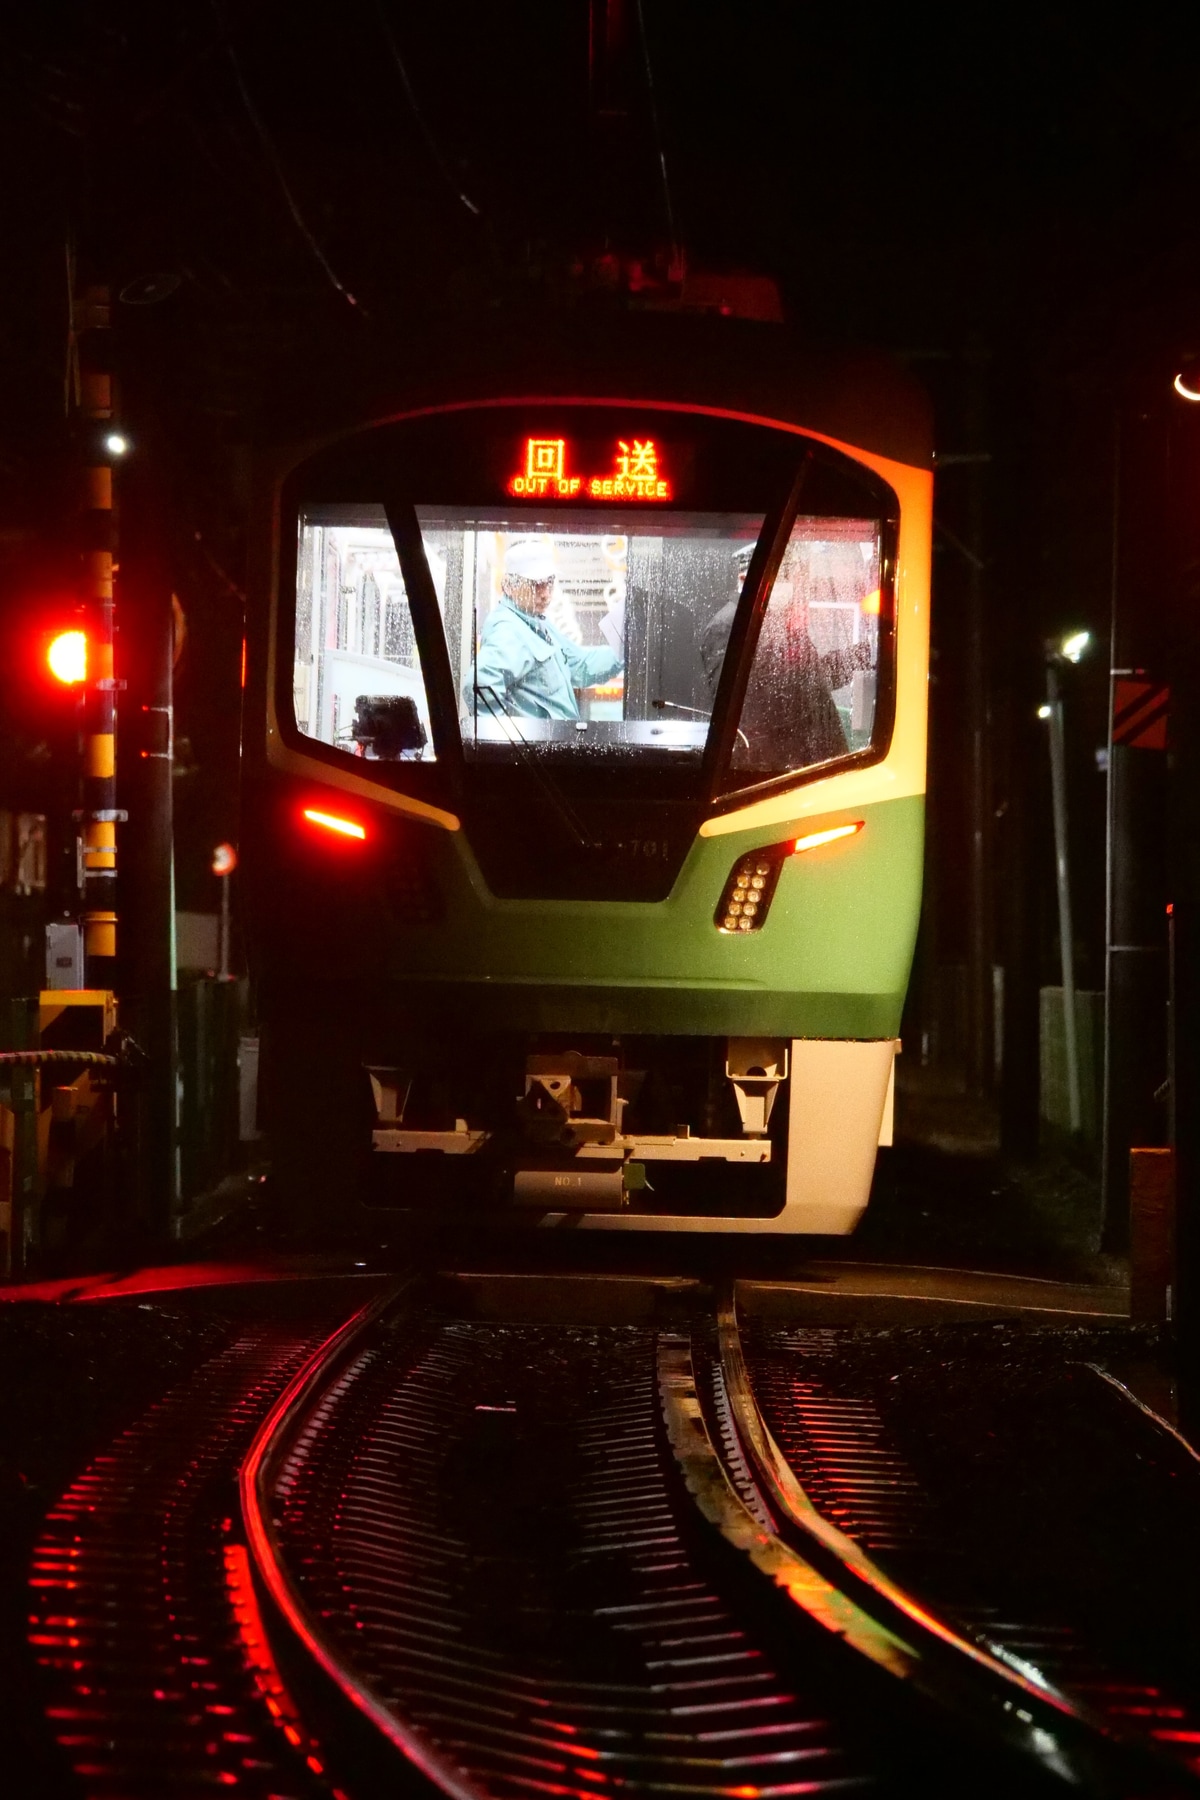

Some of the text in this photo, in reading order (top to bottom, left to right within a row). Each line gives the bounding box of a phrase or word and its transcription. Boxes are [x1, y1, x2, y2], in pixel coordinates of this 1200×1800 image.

[513, 477, 667, 497] OUT OF SERVICE
